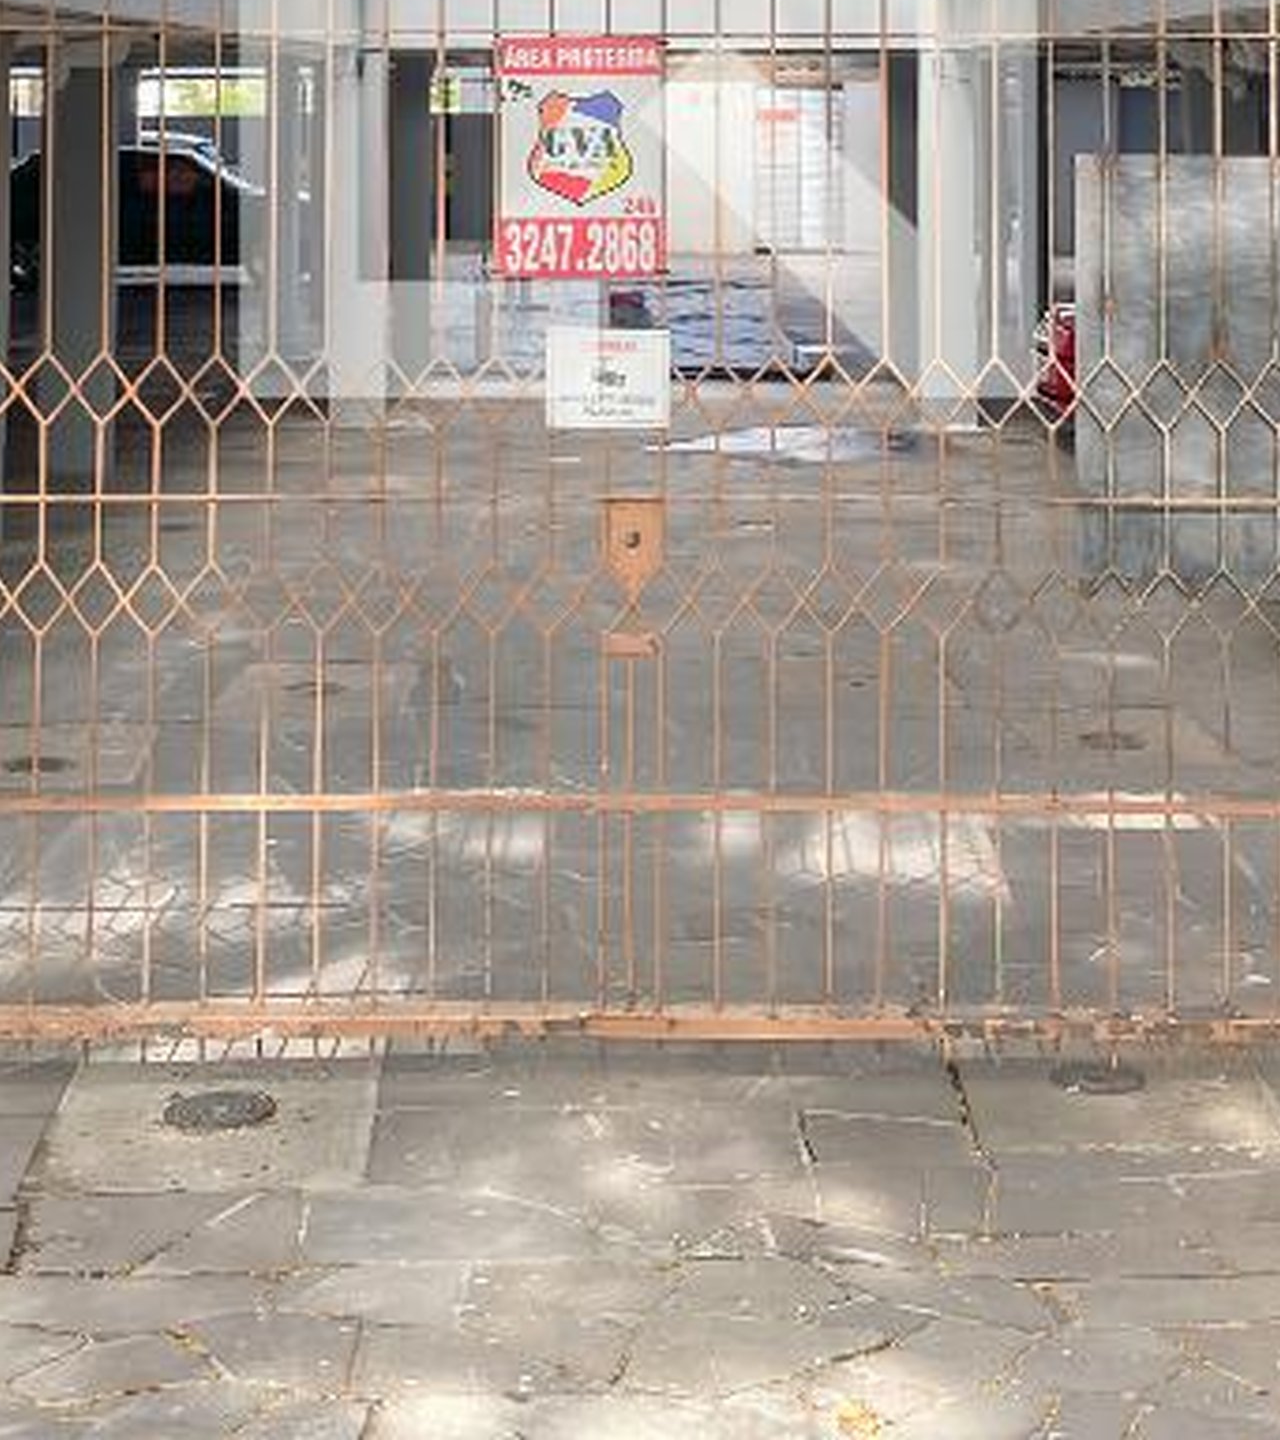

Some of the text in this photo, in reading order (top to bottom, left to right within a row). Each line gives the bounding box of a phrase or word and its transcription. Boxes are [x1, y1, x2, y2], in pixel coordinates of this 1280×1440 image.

[504, 44, 659, 69] ÁREA PROTEGIDA
[506, 224, 657, 273] 3247.2868
